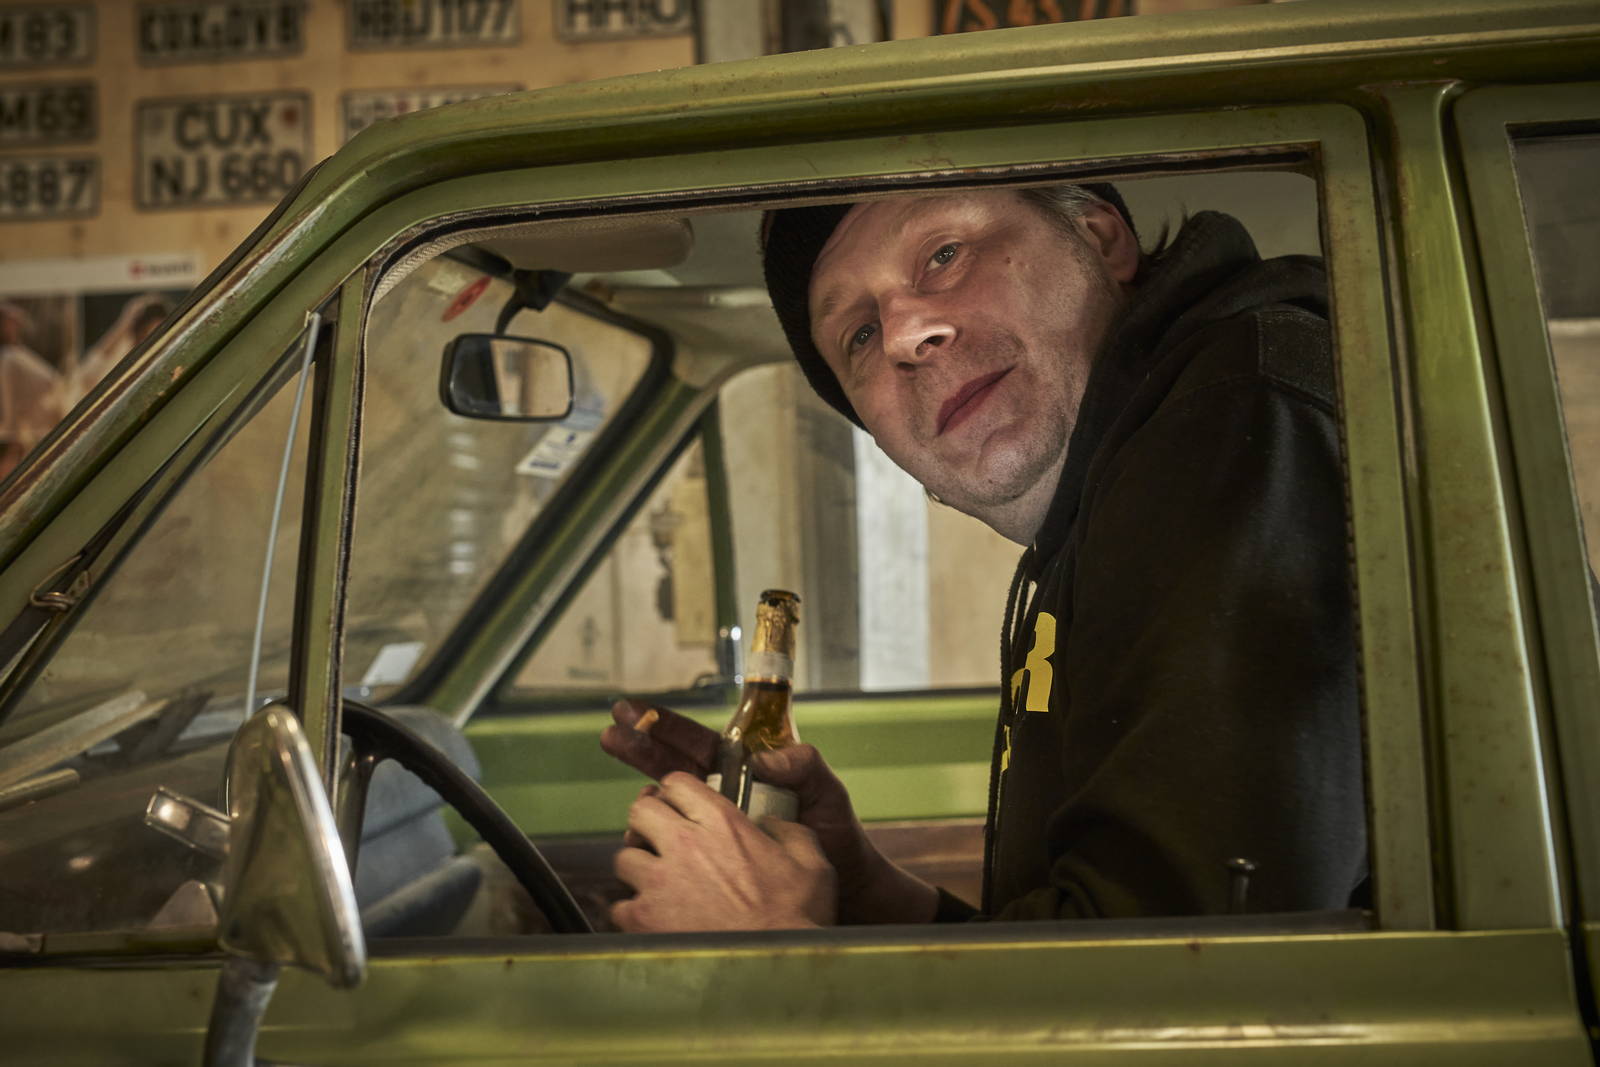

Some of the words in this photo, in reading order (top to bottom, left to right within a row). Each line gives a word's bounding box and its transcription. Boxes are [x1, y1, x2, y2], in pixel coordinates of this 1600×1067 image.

[175, 103, 273, 150] CUX
[0, 159, 92, 208] 887
[150, 156, 209, 202] NJ
[219, 149, 303, 196] 660
